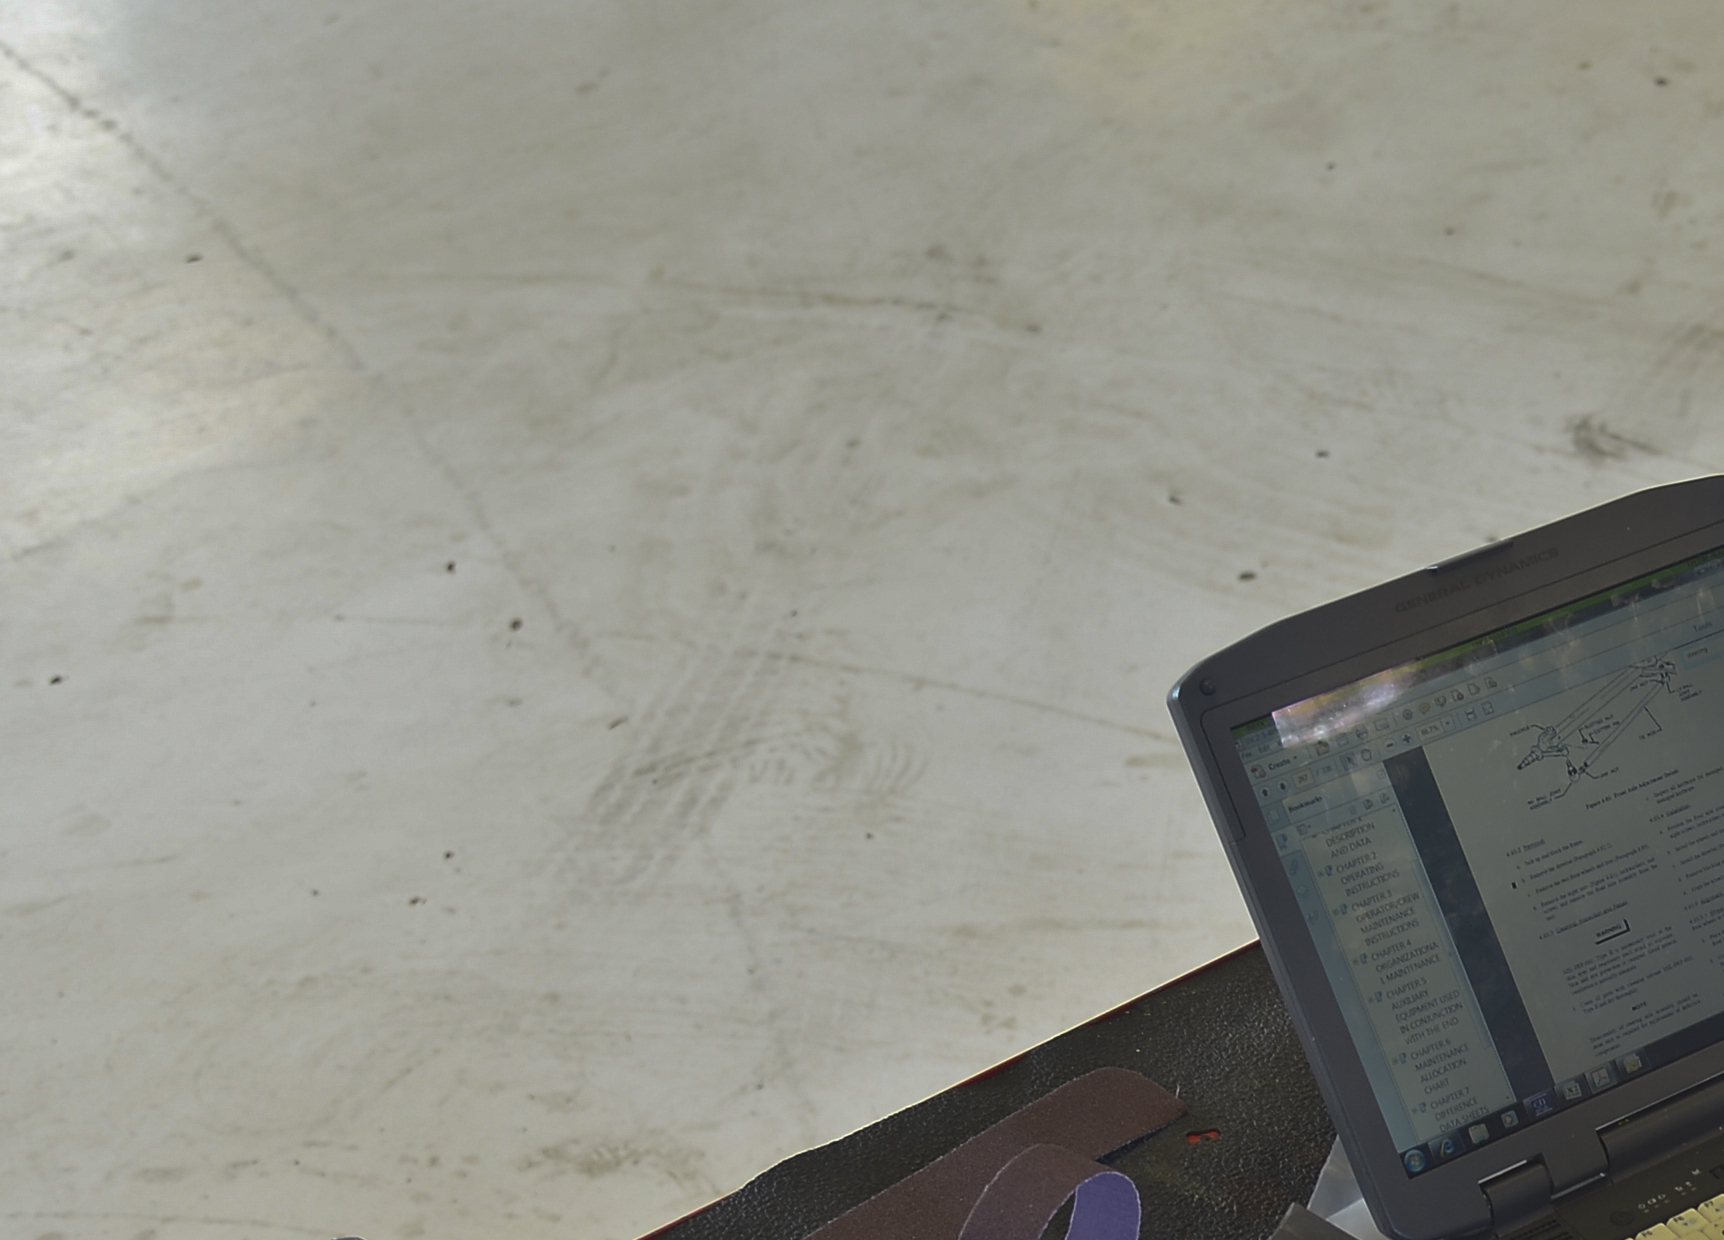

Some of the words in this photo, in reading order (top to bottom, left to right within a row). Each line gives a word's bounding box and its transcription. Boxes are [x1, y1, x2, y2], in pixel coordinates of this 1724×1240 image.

[1394, 580, 1471, 614] GENERAL
[1473, 547, 1560, 588] DYNAMICS
[1692, 620, 1712, 633] Tools
[1268, 758, 1291, 771] Create
[1288, 796, 1322, 813] Bookmarks
[1324, 821, 1376, 847] DESCRIPTION
[1330, 844, 1349, 859] AND
[1348, 836, 1372, 851] DATA
[1335, 853, 1370, 873] CHAPTER
[1340, 863, 1384, 885] OPERATING
[1344, 870, 1396, 897] INSTRUCTIONS
[1350, 892, 1386, 912] CHAPTER
[1356, 890, 1420, 924] OPERATOR/CREW
[1360, 906, 1415, 934] MAINTENANCE
[1596, 923, 1622, 938] WARNING
[1364, 918, 1420, 947] INSTRUCTIONS
[1370, 941, 1406, 961] CHAPTER
[1386, 952, 1440, 982] MAINTENANCE
[1385, 978, 1421, 1000] CHAPTER
[1390, 988, 1429, 1010] AUXILIARY
[1394, 998, 1438, 1022] EQUIPMENT
[1438, 989, 1460, 1004] USED
[1409, 1001, 1464, 1030] CONJUNCTION
[1404, 1030, 1426, 1046] WITH
[1425, 1024, 1440, 1036] THE
[1441, 1016, 1459, 1030] END
[1410, 1040, 1445, 1060] CHAPTER
[1414, 1042, 1470, 1072] MAINTENANCE
[1420, 1057, 1467, 1084] ALLOCATION
[1424, 1078, 1450, 1095] CHART
[1430, 1088, 1466, 1110] CHAPTER
[1434, 1096, 1478, 1122] DIFFERENCE
[1438, 1117, 1462, 1134] DATA
[1460, 1105, 1490, 1124] SHEETS
